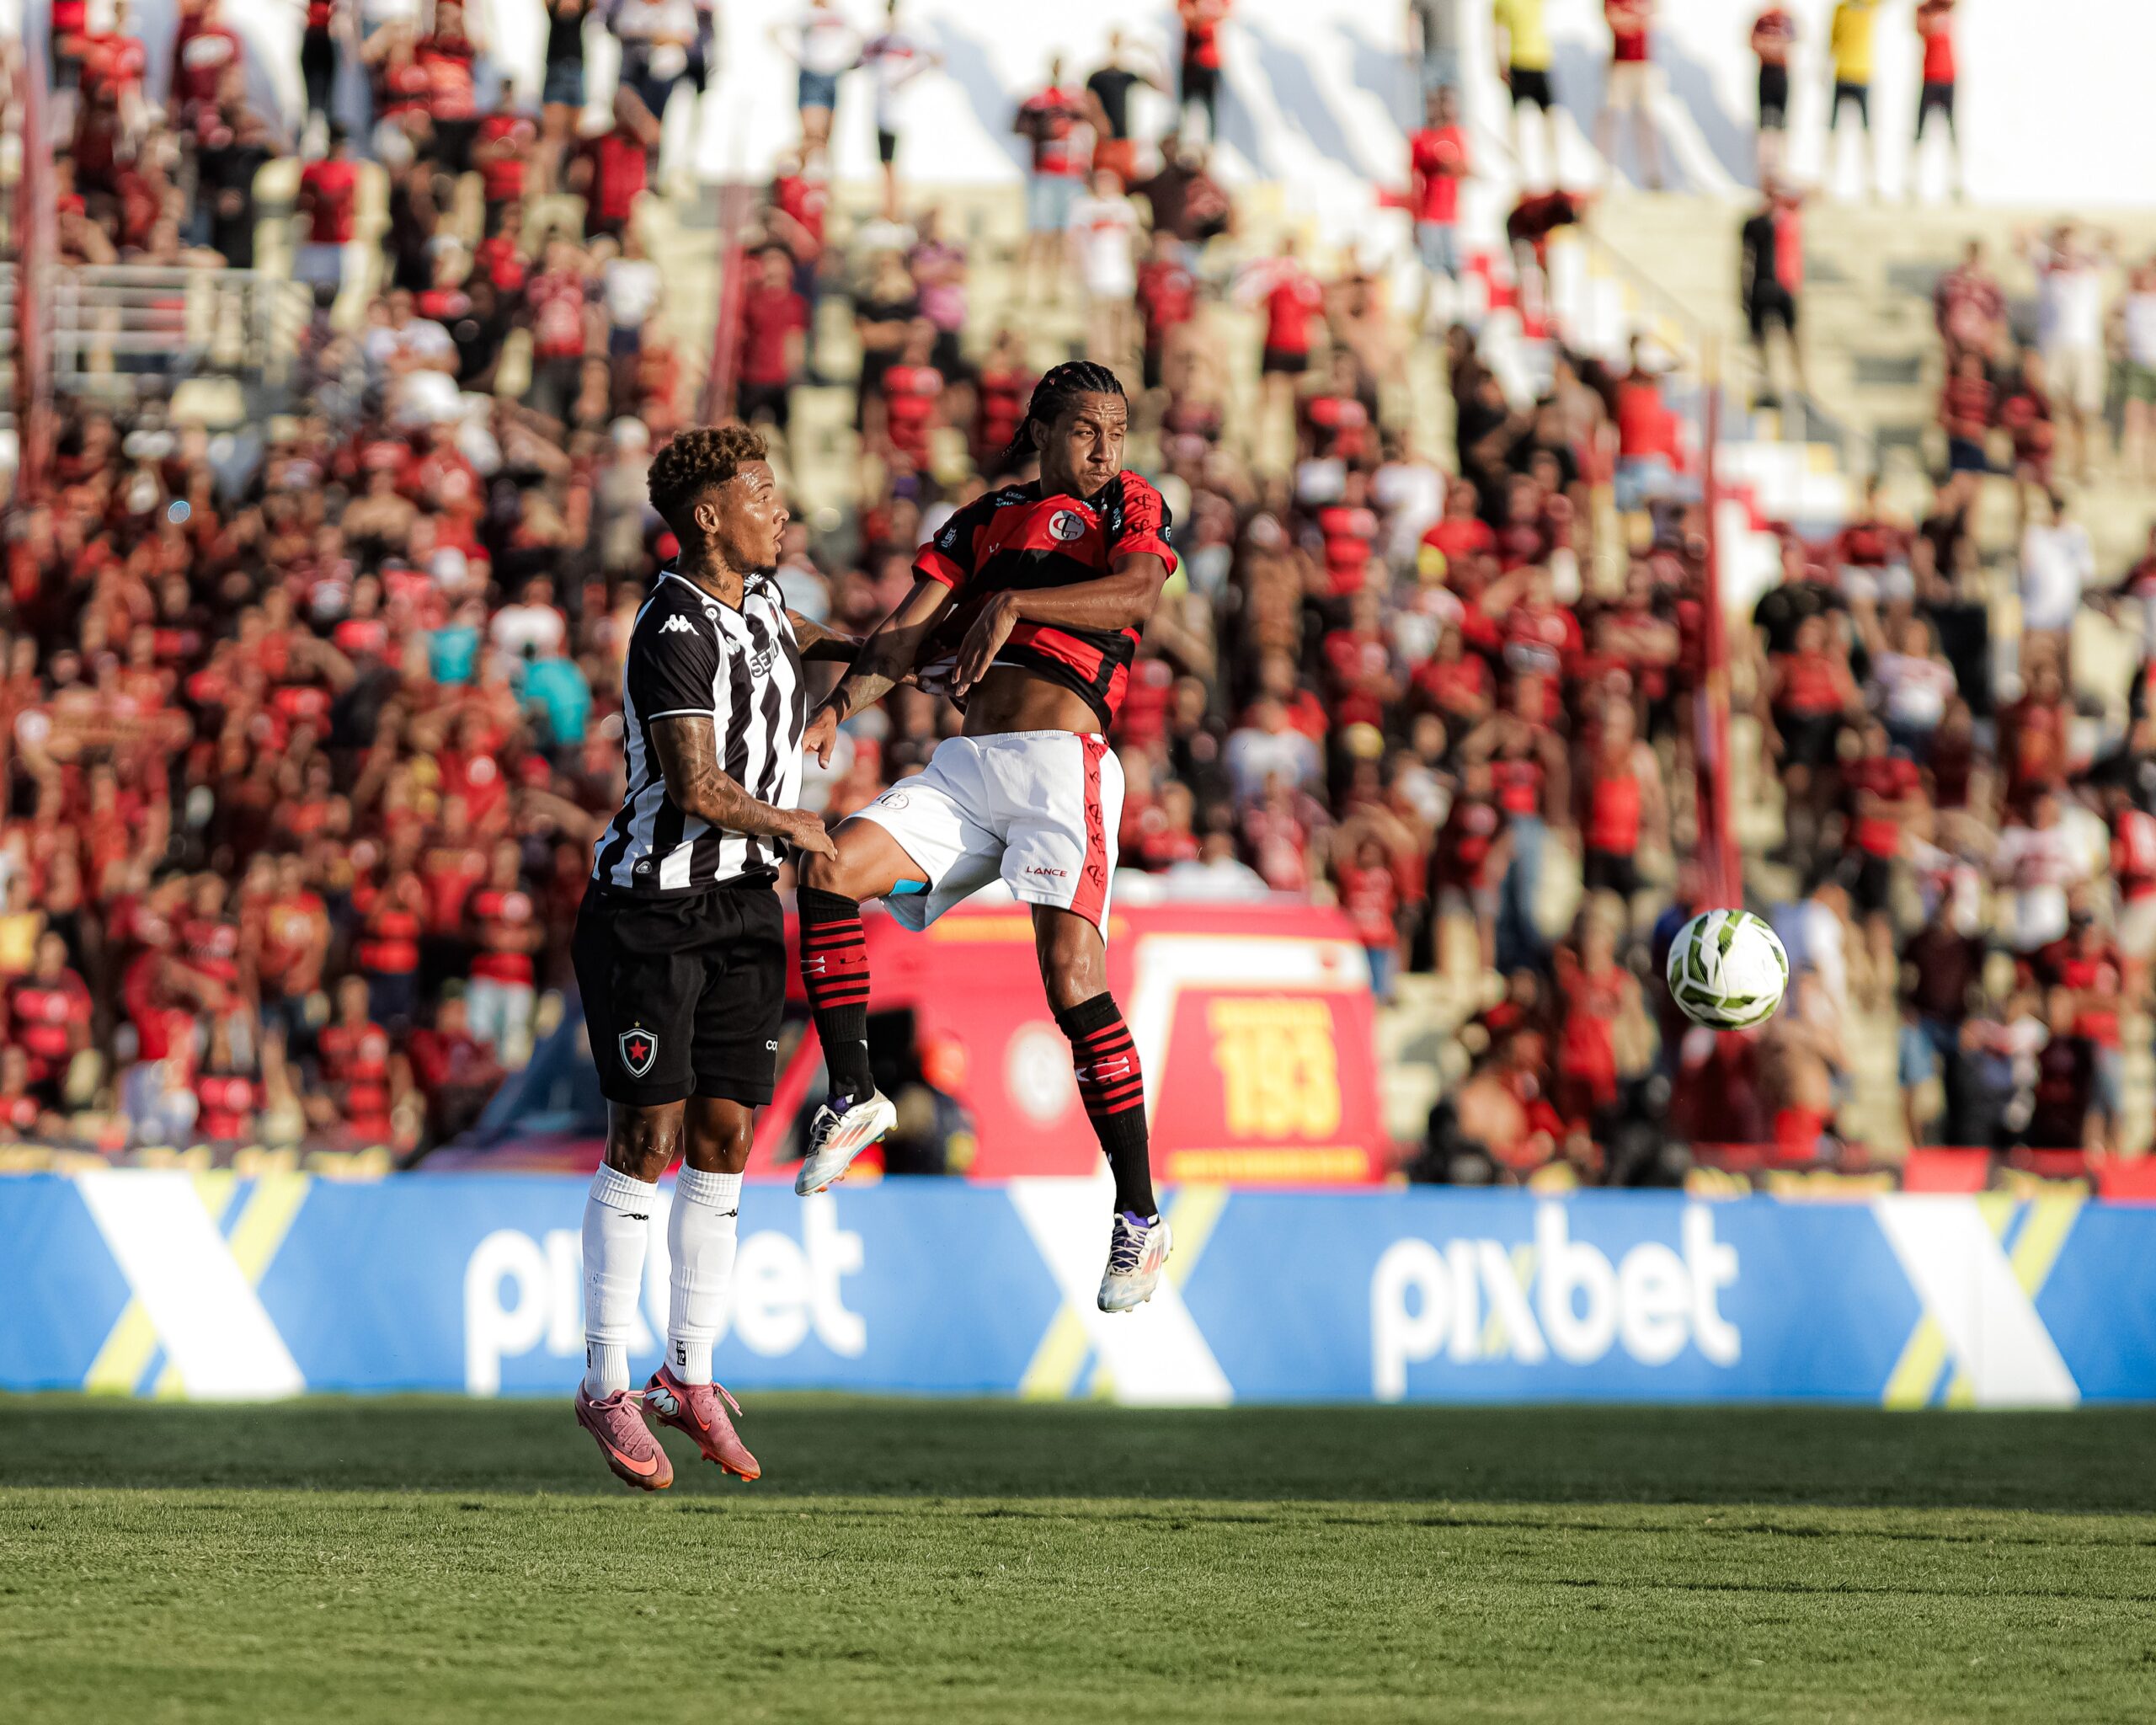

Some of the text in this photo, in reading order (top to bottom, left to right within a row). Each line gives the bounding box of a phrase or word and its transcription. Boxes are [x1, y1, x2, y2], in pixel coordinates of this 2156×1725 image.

[1025, 865, 1068, 878] LANCE
[463, 1189, 867, 1397] piet
[1370, 1199, 1741, 1399] pixbet
